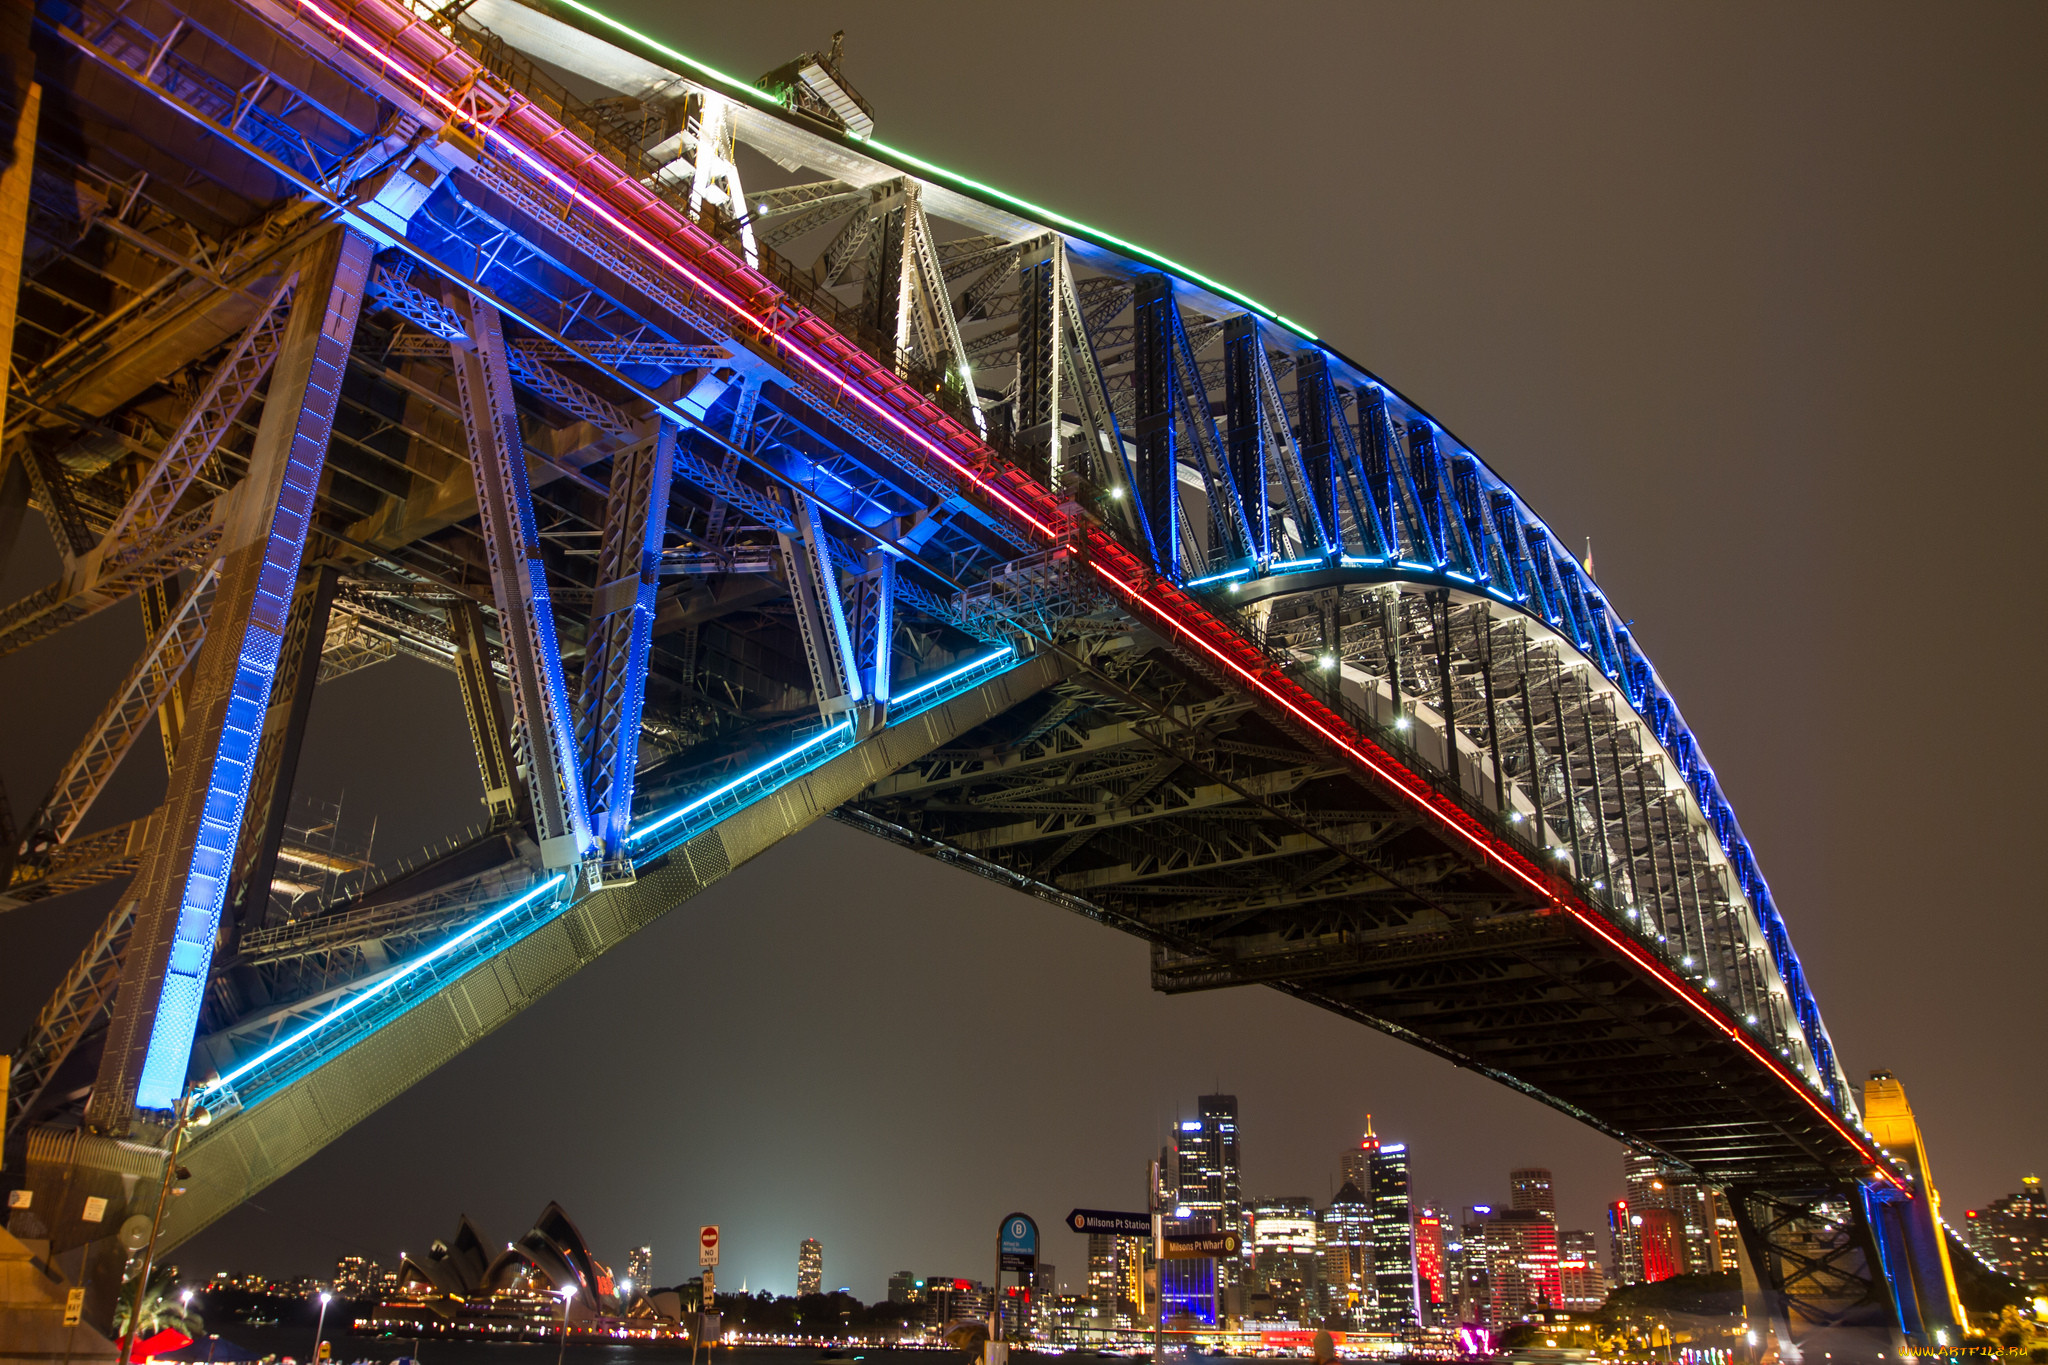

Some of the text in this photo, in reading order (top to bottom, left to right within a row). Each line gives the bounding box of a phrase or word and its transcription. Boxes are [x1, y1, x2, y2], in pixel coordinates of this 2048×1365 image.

[1086, 1217, 1114, 1228] Milsons
[1115, 1218, 1123, 1229] Pt
[1125, 1219, 1150, 1230] Station
[1169, 1242, 1193, 1252] Milsons
[1194, 1240, 1202, 1250] Pt
[1203, 1239, 1224, 1250] Wharf
[704, 1249, 714, 1257] NO
[704, 1274, 713, 1283] ONE
